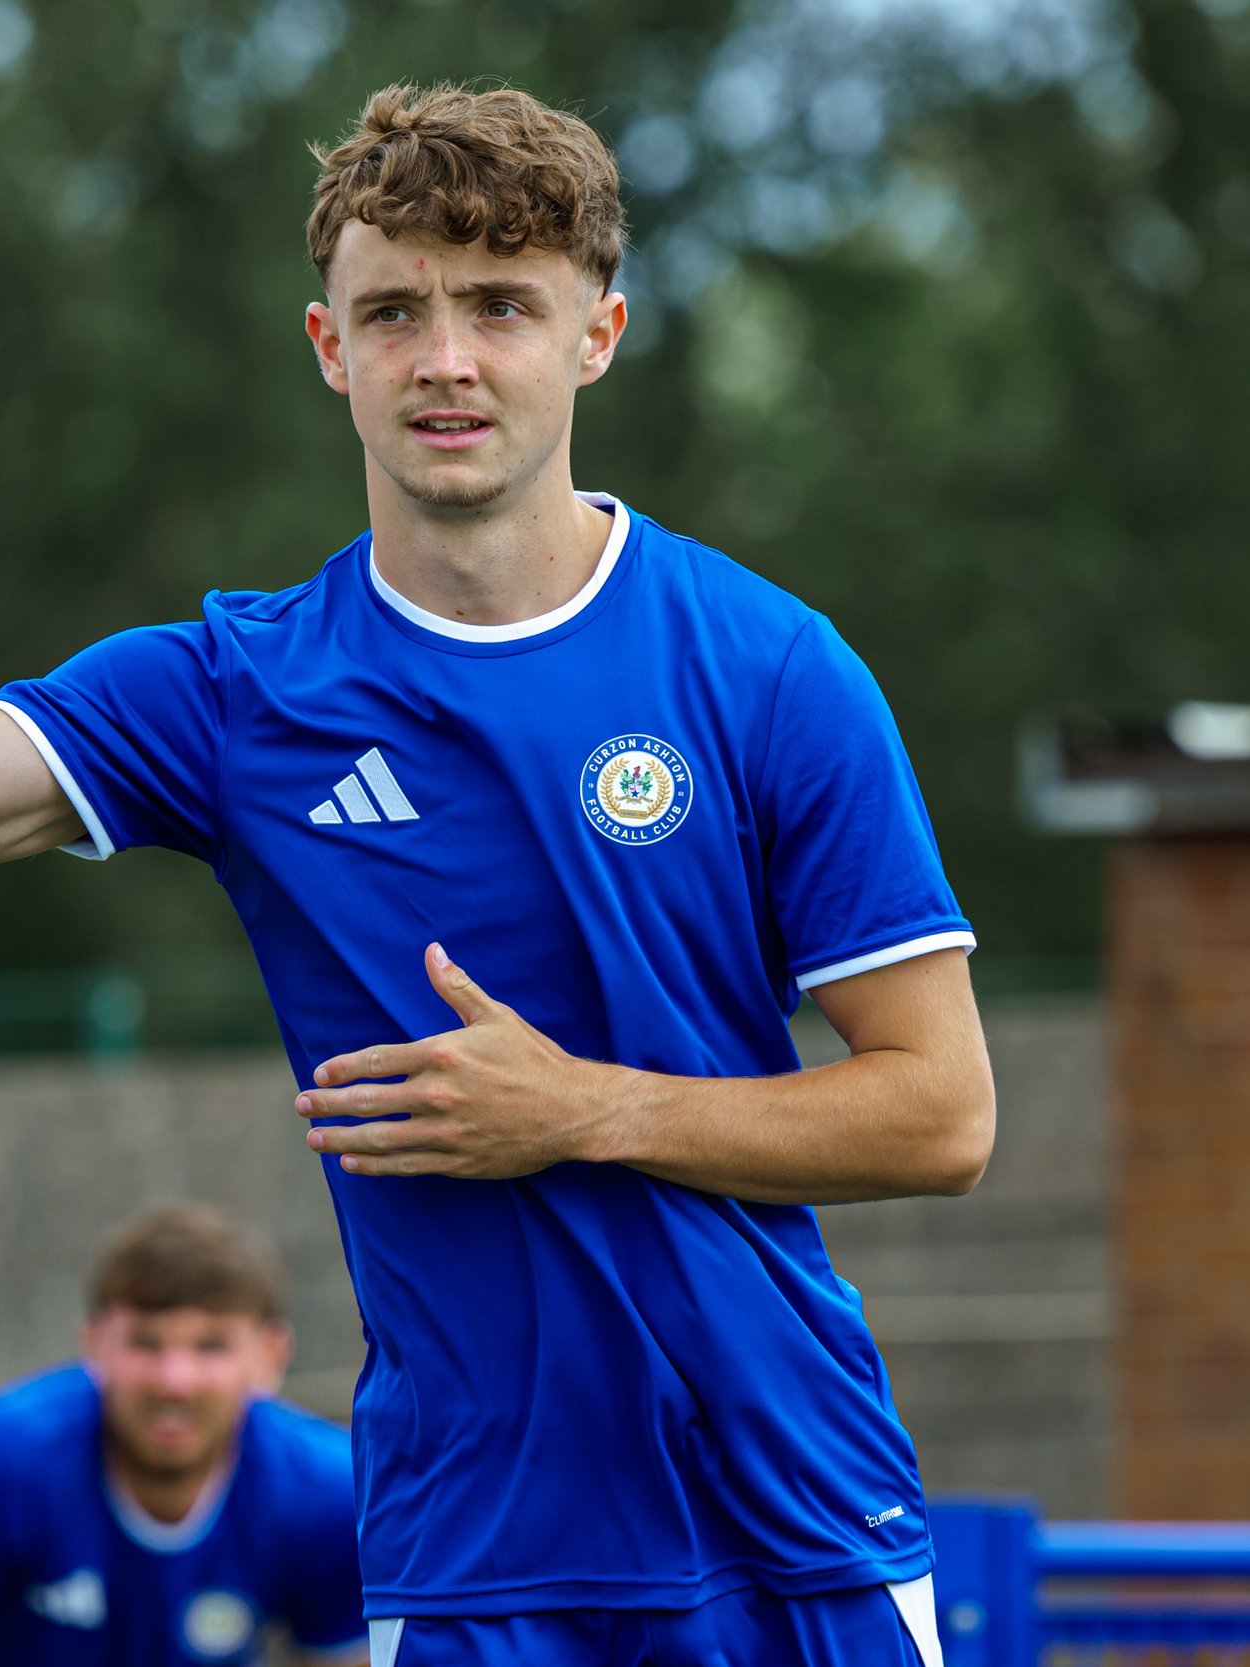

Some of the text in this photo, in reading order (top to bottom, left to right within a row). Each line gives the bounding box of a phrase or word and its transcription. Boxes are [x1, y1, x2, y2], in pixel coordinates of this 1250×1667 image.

[588, 738, 686, 782] CURZON ASHTON
[587, 798, 682, 840] FOOTBALL CLUB
